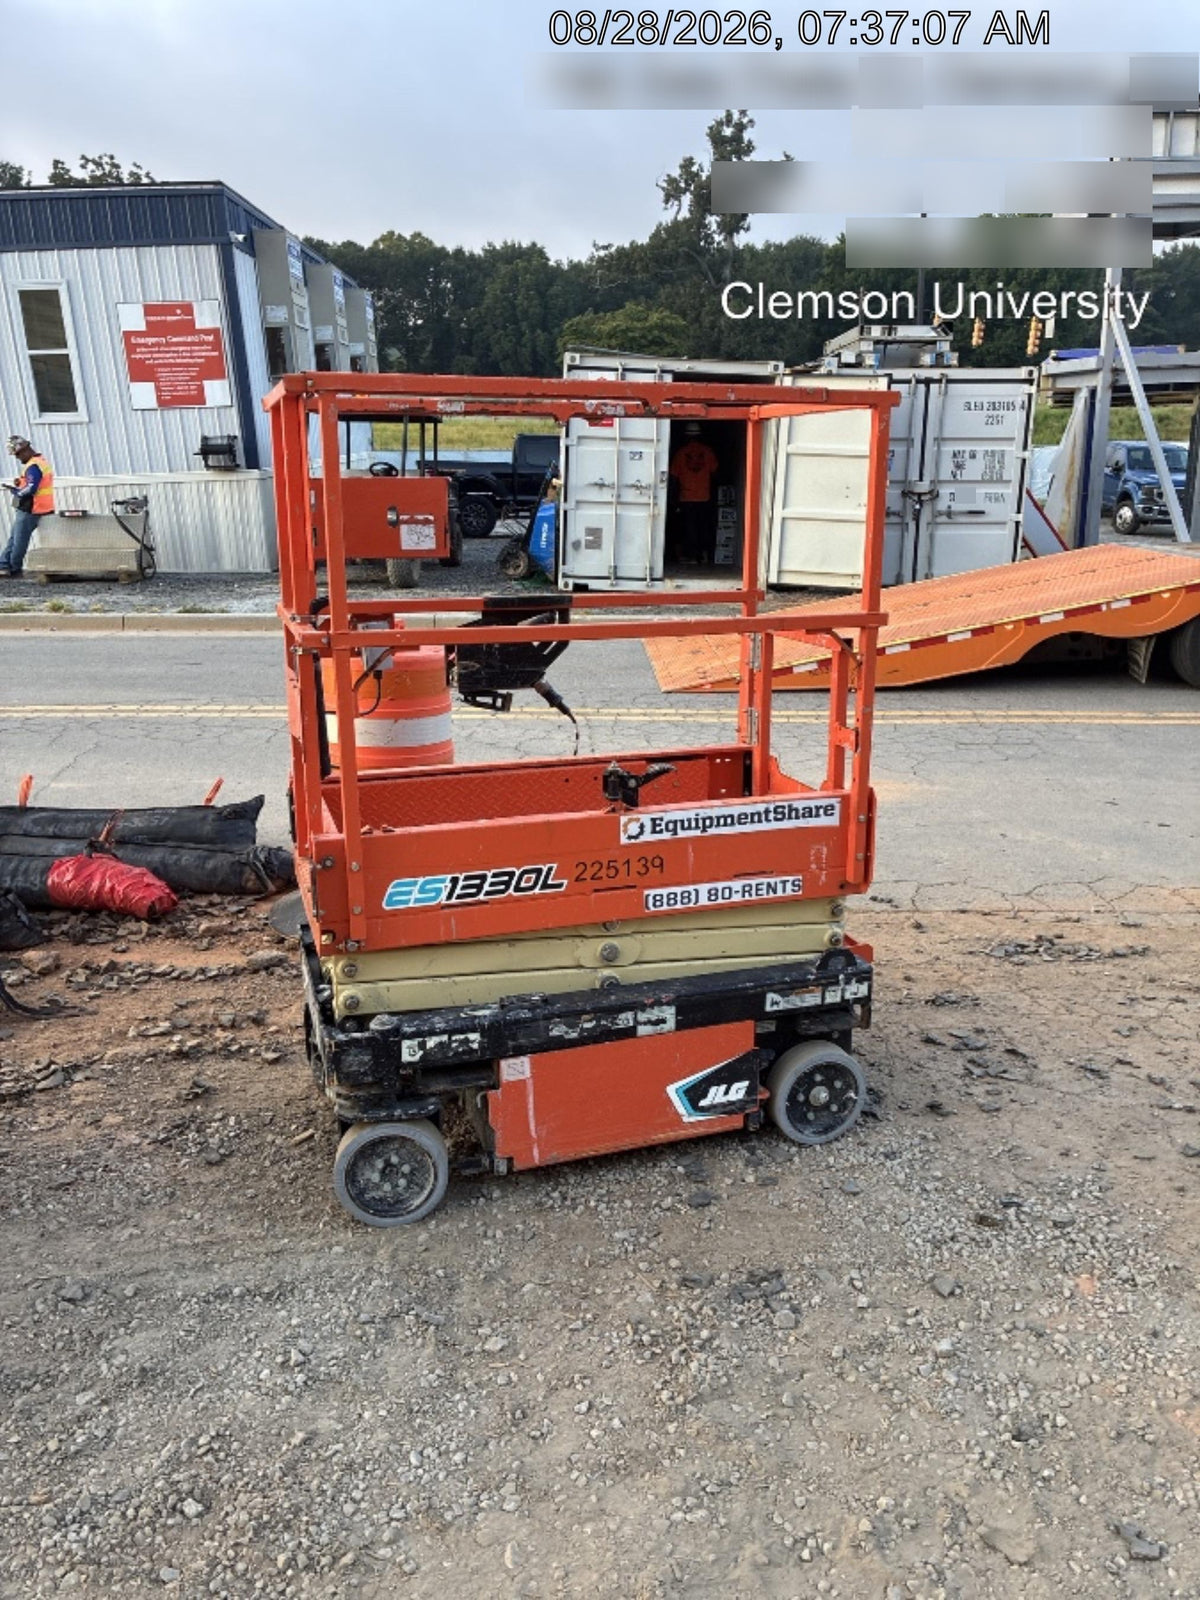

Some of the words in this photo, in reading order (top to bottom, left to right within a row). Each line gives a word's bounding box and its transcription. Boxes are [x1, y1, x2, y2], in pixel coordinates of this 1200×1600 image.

[650, 802, 835, 836] EquipmentShare
[574, 854, 665, 882] 225139
[384, 865, 566, 908] ES1330L
[644, 888, 699, 910] (888)
[707, 879, 803, 902] 80-RENTS
[698, 1080, 750, 1107] JLG
